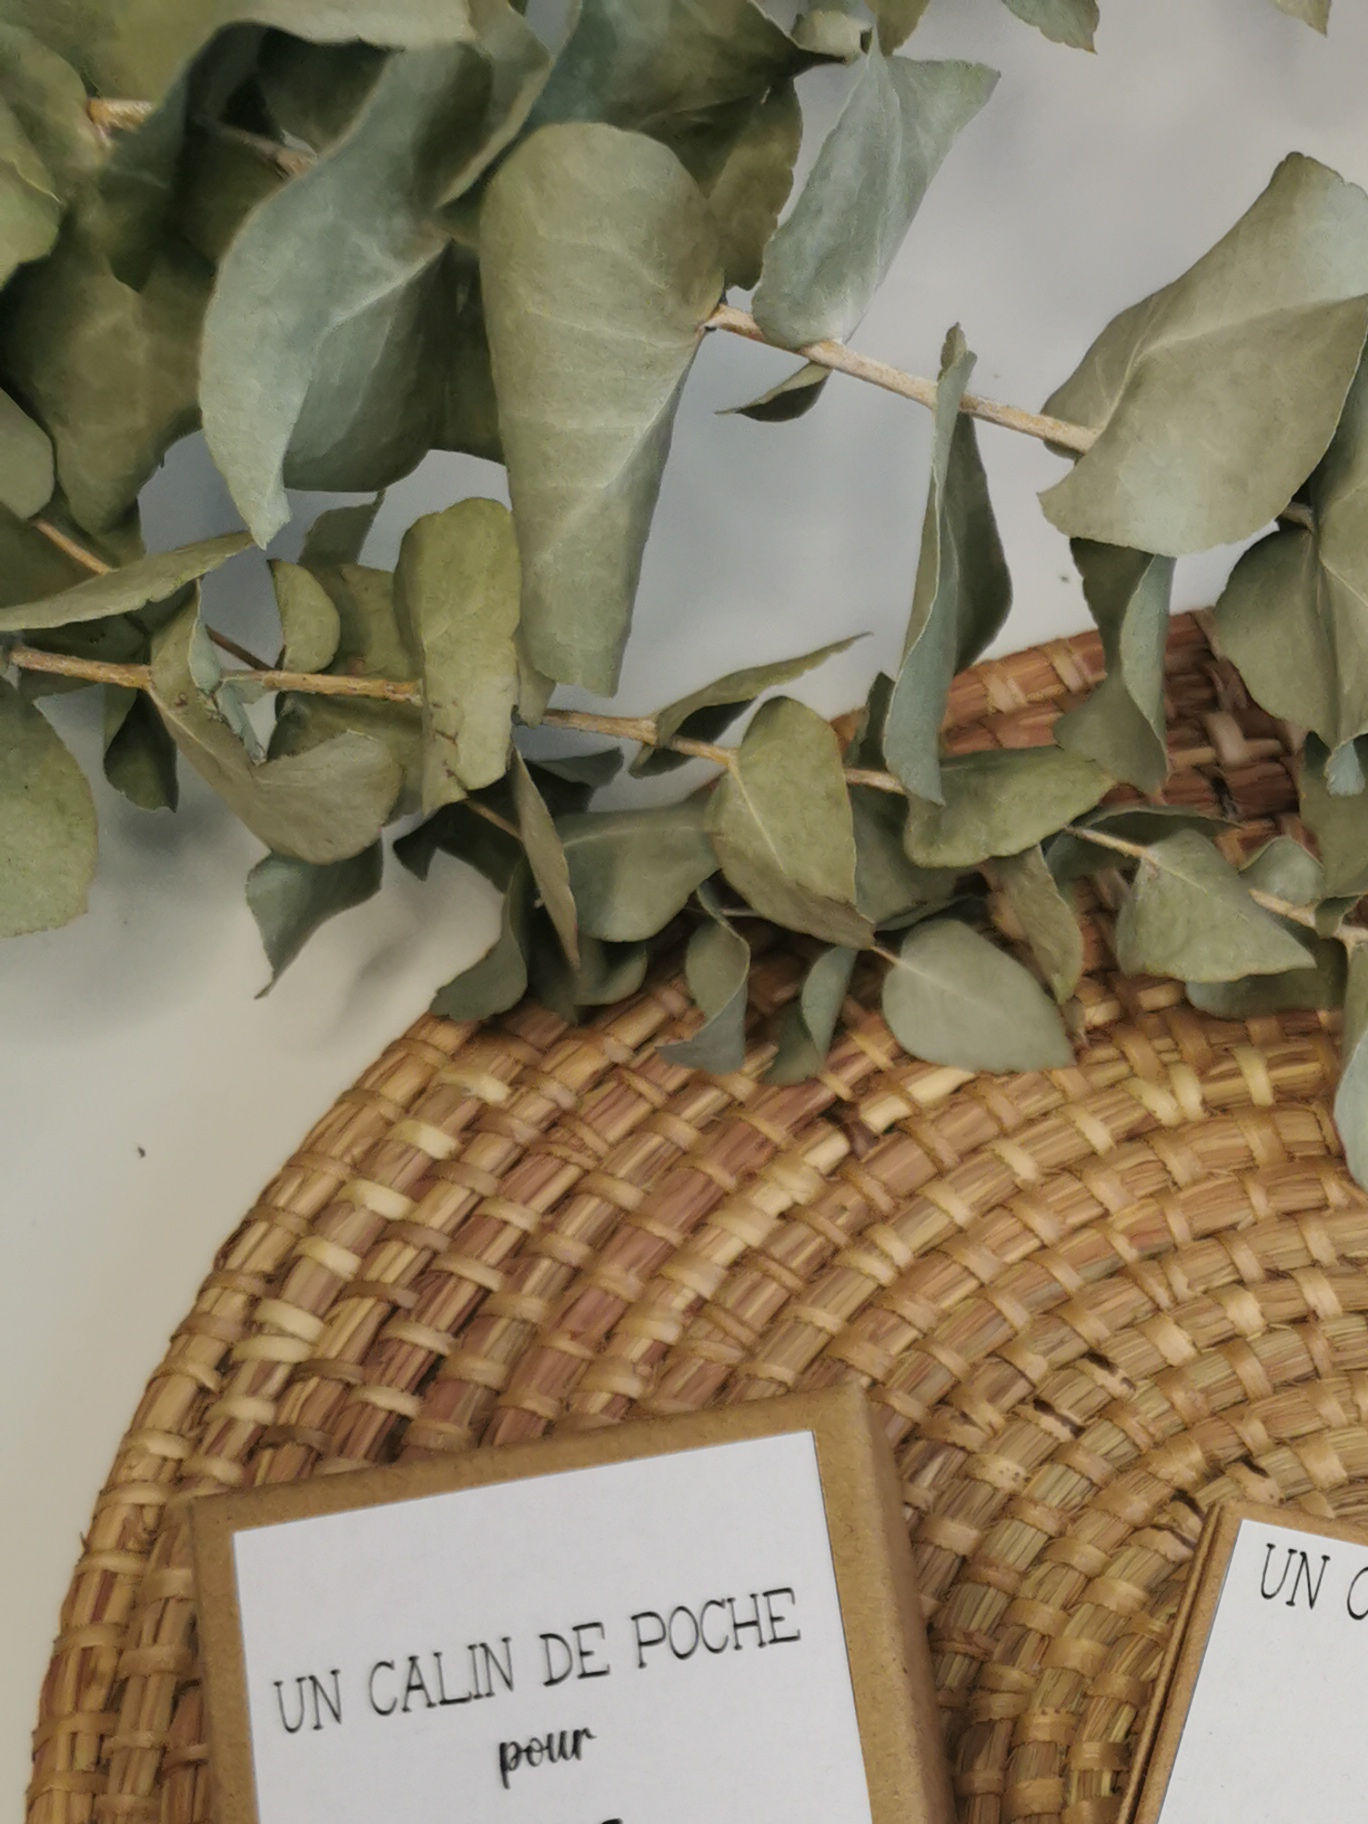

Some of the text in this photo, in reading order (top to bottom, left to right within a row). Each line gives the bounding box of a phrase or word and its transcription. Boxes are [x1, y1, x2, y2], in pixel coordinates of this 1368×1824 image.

[1260, 1542, 1331, 1610] UN
[272, 1586, 801, 1735] UN CALIN DE POCHE
[498, 1727, 596, 1790] pour
